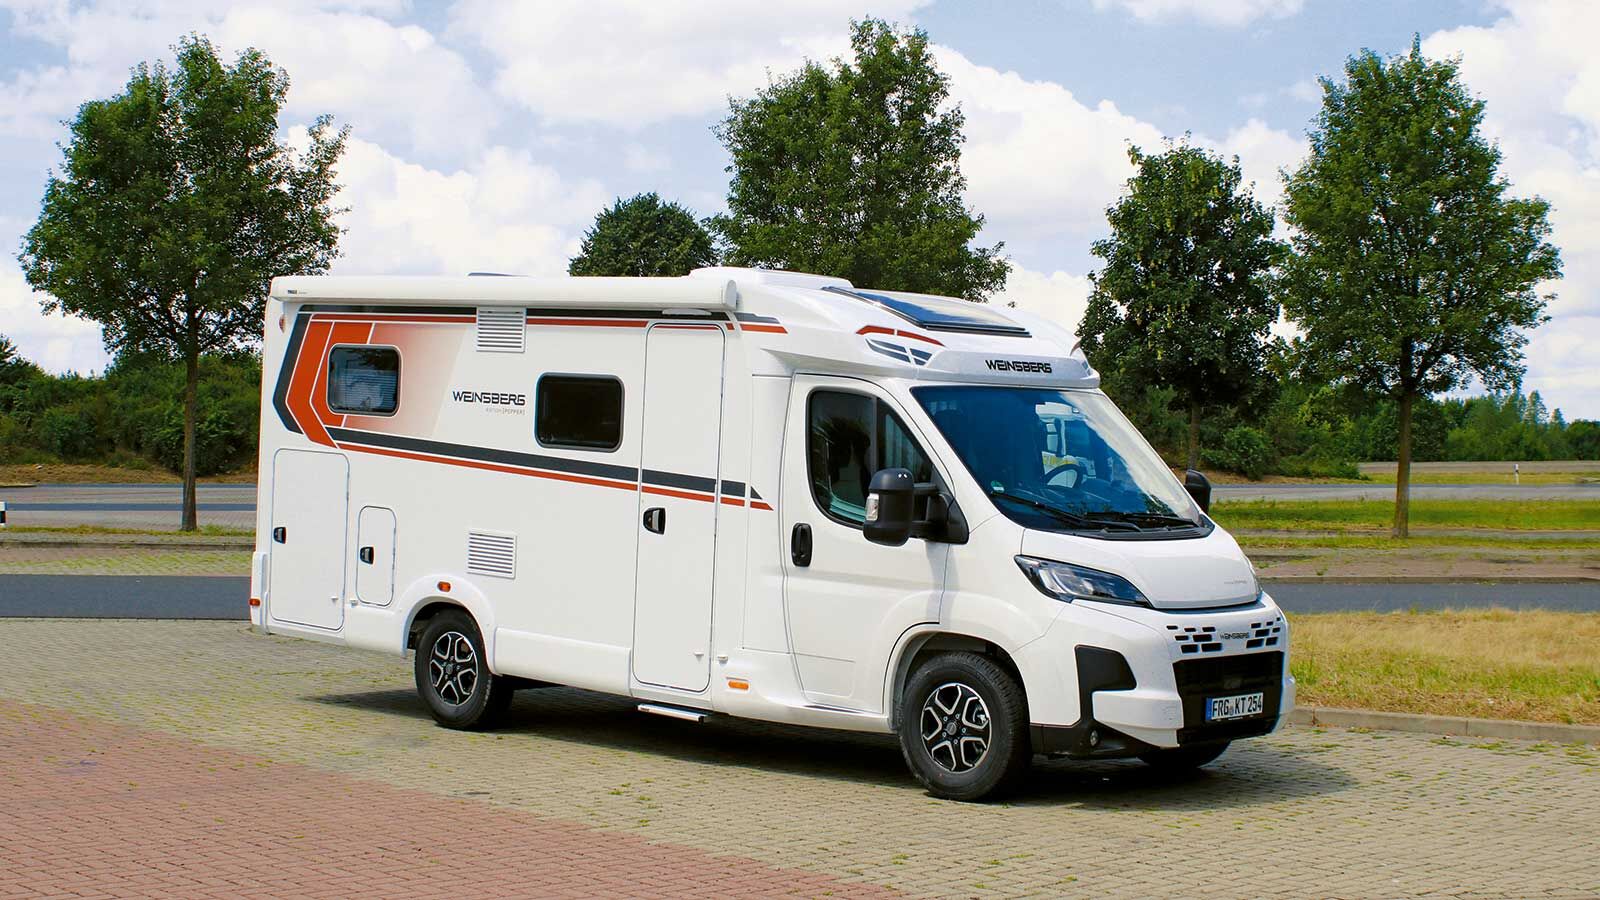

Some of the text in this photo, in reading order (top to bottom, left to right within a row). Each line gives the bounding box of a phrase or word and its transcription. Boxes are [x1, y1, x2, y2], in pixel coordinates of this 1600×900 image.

[985, 360, 1052, 373] WEINSBERG
[452, 391, 526, 406] WEINSBERG
[1212, 695, 1262, 717] FRG KT 254
